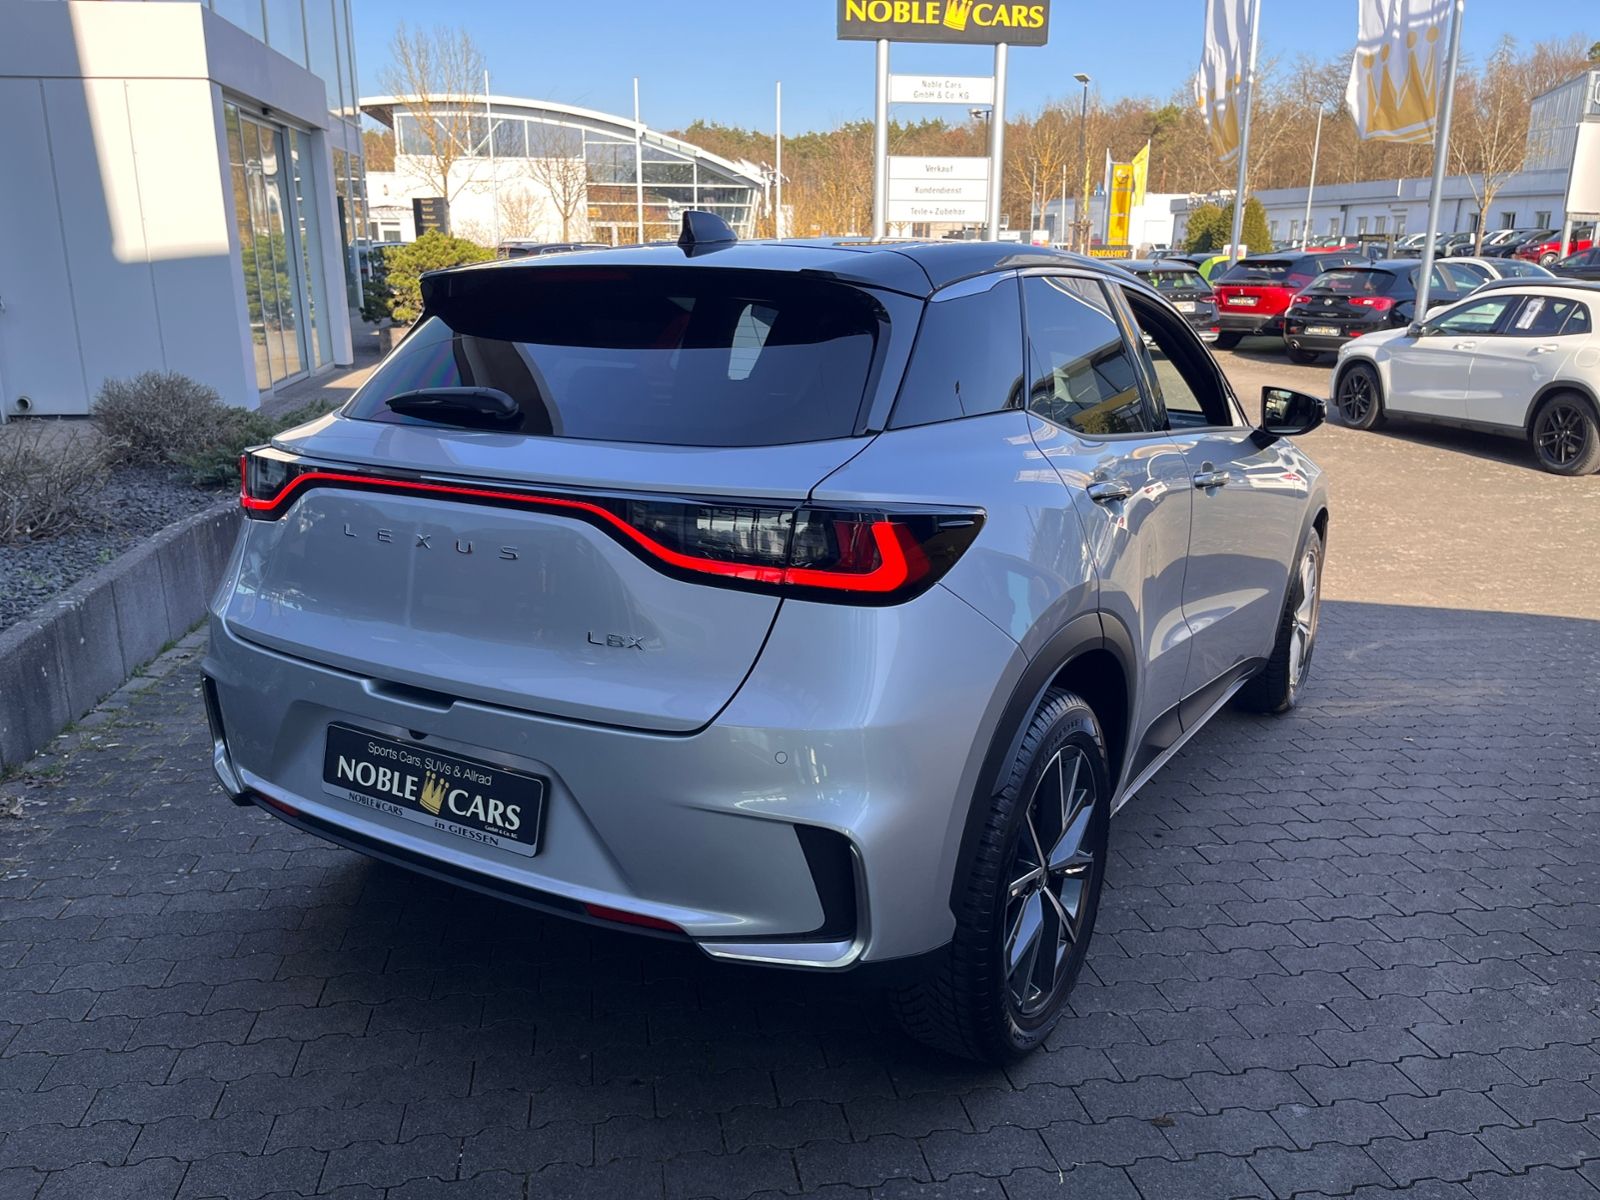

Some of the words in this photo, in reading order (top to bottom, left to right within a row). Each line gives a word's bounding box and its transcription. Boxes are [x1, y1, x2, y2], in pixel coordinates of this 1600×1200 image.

[846, 0, 940, 24] NOBLE
[972, 3, 1044, 28] CARS
[913, 90, 935, 98] GmbH
[959, 91, 970, 99] KG
[921, 80, 942, 88] Noble
[945, 80, 962, 88] Cars
[925, 164, 953, 173] Verkauf
[914, 186, 962, 194] Kundendienst
[343, 523, 519, 560] LEXUS
[587, 631, 646, 650] LBX
[368, 742, 397, 760] Sports
[399, 751, 423, 769] Cars,
[424, 757, 452, 775] SUVs
[453, 766, 461, 777] &
[463, 769, 493, 786] Allrad
[337, 755, 419, 801] NOBLE
[448, 789, 521, 830] CARS
[349, 791, 376, 808] NOBLE
[380, 801, 404, 816] CARS
[434, 819, 445, 830] in
[448, 823, 500, 847] GIESSEN
